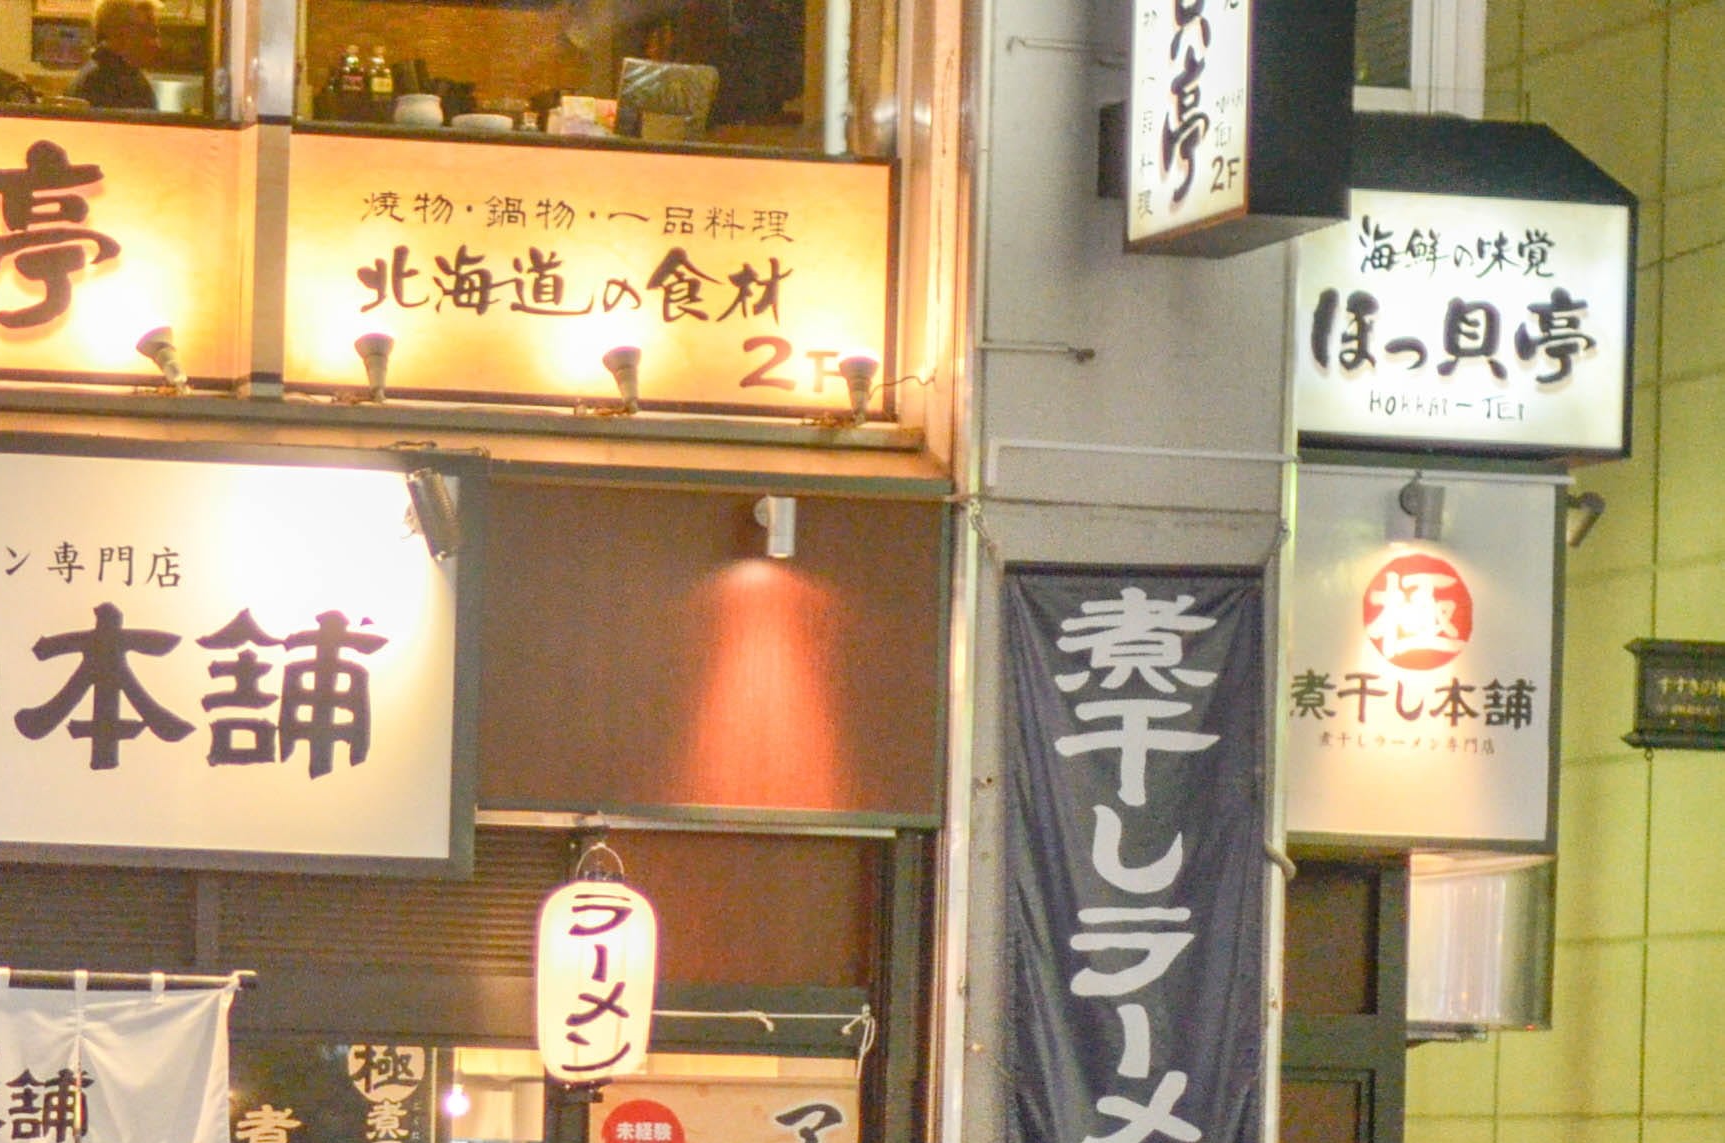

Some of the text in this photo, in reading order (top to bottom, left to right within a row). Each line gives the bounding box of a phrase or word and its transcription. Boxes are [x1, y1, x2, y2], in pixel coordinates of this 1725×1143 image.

[1210, 155, 1240, 194] 2F
[357, 244, 794, 325] 北海道の食材
[1358, 214, 1557, 278] 海鮮の味覚
[1310, 286, 1597, 385] ほっ貝亭
[1364, 571, 1473, 658] 極
[1289, 668, 1538, 730] 煮干し本舗
[561, 893, 633, 1072] ラーメン
